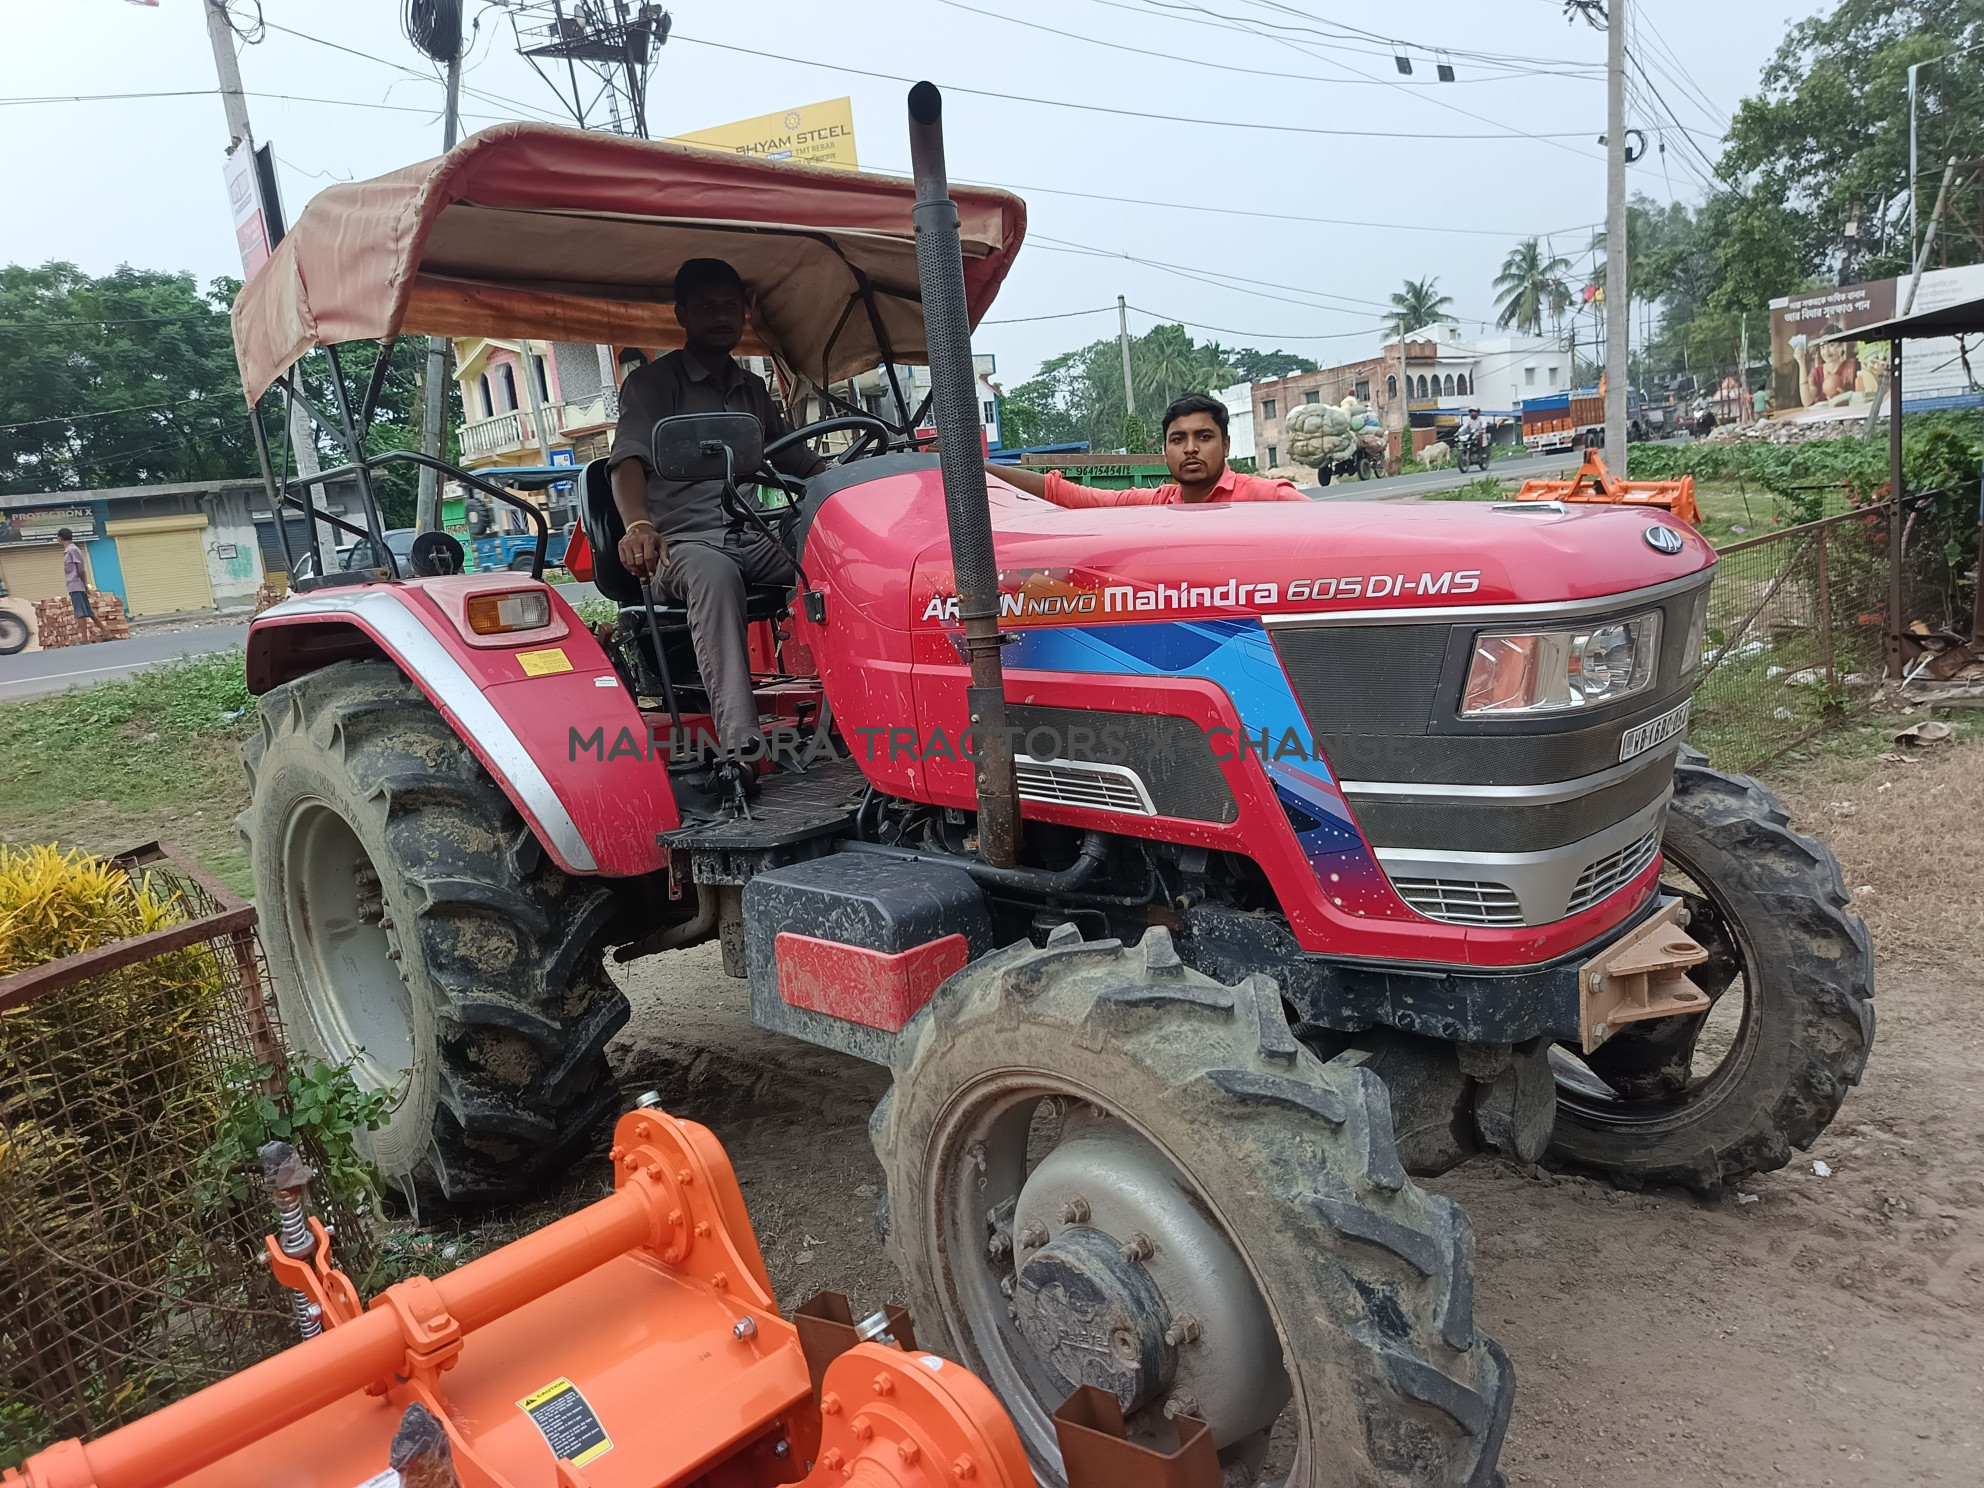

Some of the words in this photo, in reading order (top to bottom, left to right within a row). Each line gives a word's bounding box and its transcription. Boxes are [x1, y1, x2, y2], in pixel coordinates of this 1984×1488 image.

[736, 135, 791, 156] SHYAM
[797, 125, 851, 144] STEEL
[795, 146, 811, 156] TMT
[812, 142, 836, 153] REBAR
[12, 509, 83, 521] PROTECTION
[922, 592, 1025, 622] ARN
[1027, 593, 1097, 616] NOVO
[1104, 578, 1278, 612] Mahindra
[536, 1380, 566, 1398] CAUTION
